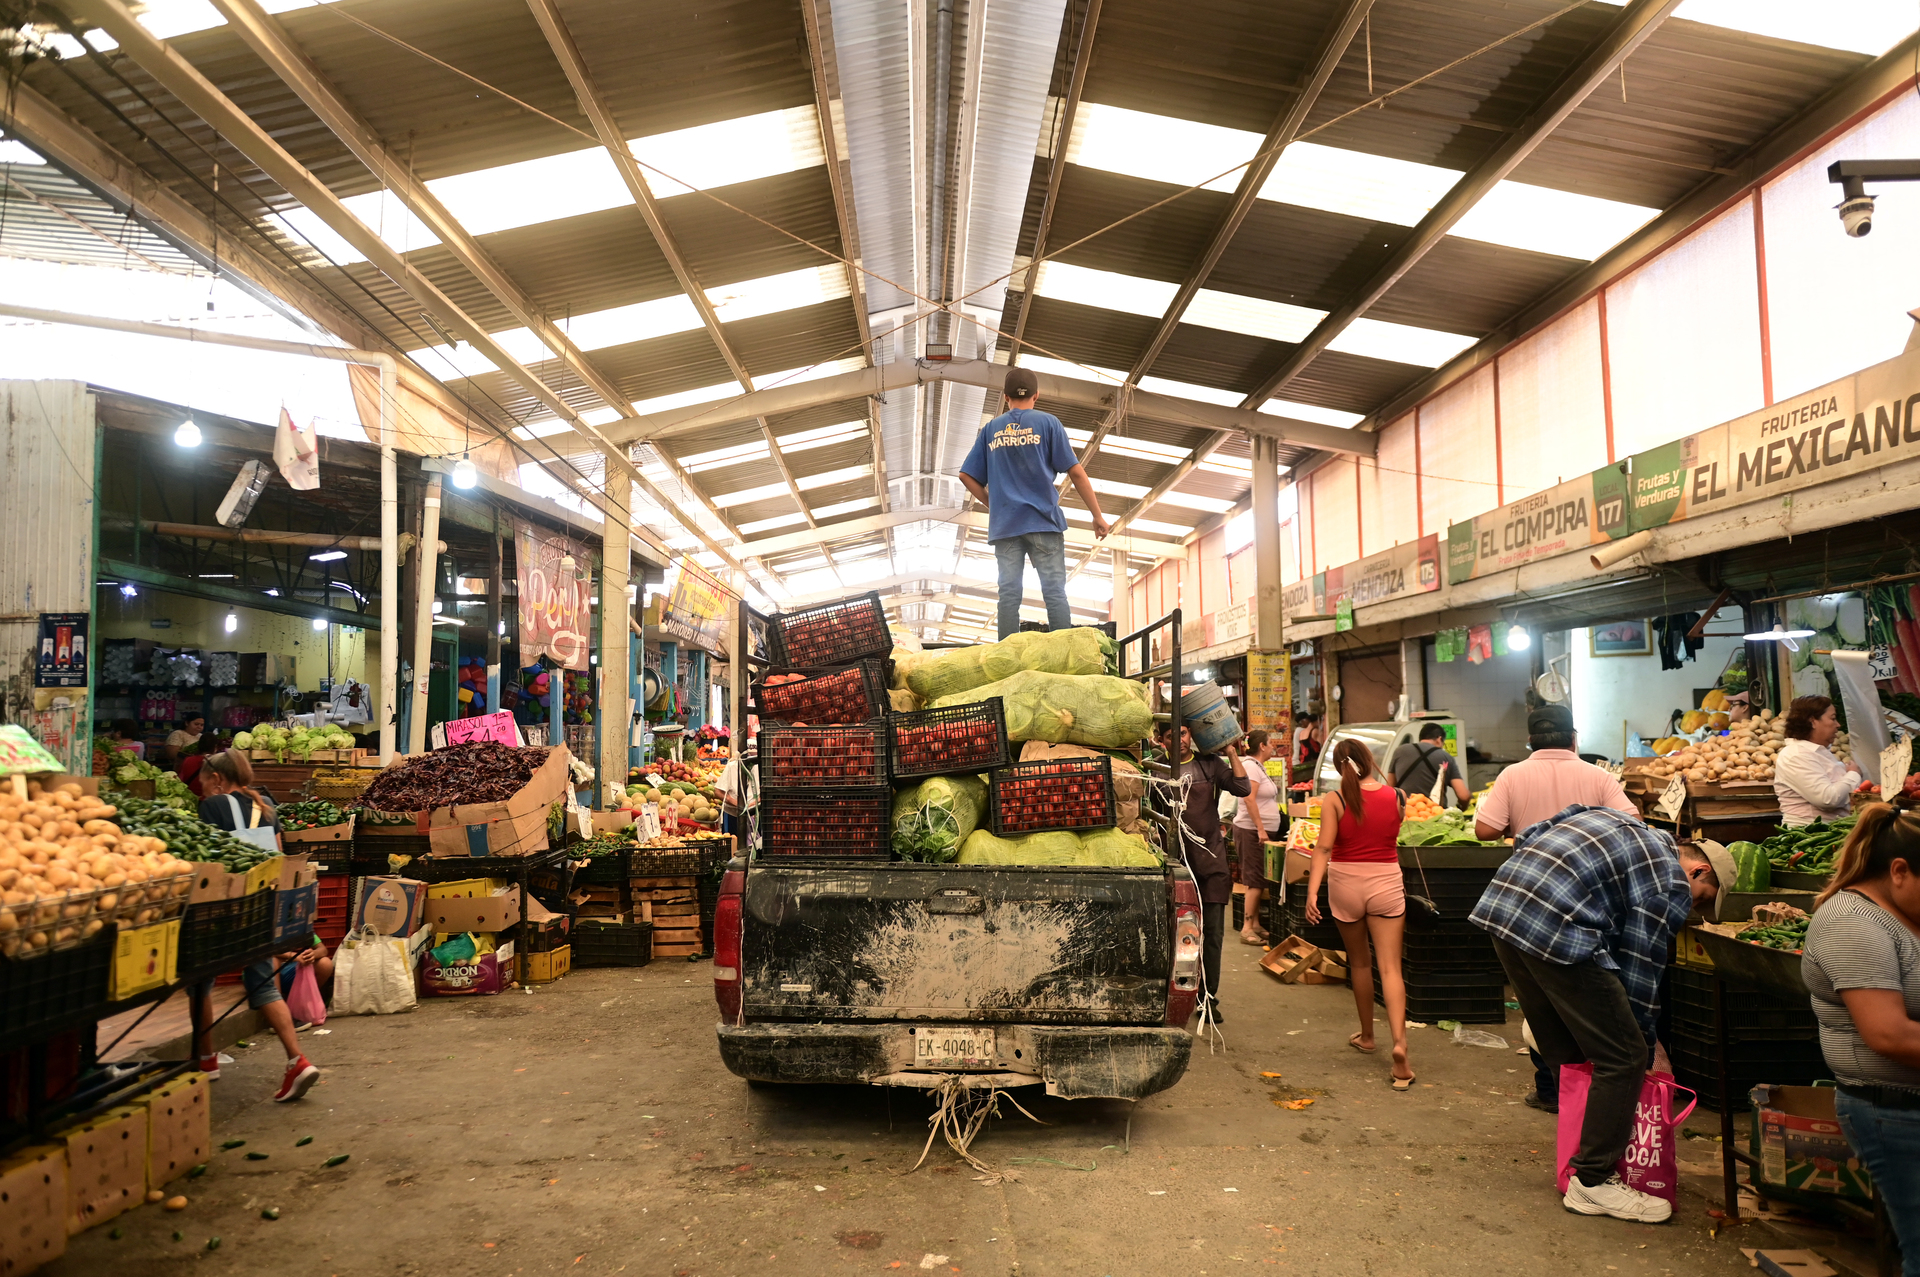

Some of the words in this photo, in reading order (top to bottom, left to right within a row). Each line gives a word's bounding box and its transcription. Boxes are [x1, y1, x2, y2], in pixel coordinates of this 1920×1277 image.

[1761, 396, 1838, 438] FRUTERIA
[988, 434, 1041, 451] WARRIORS
[1692, 461, 1726, 505] EL
[1737, 391, 1920, 492] MEXICANO
[1637, 472, 1670, 492] Frutas
[1672, 469, 1680, 485] y
[1510, 495, 1549, 518] FRUTERIA
[1634, 485, 1680, 508] Verduras
[1599, 499, 1622, 526] 177
[1480, 529, 1499, 559] EL
[1504, 497, 1588, 551] COMPIRA
[1421, 562, 1435, 581] 175
[1352, 567, 1405, 602] MENDOZA
[1282, 584, 1309, 611] ENDOZA
[667, 619, 693, 641] MAYOREO
[434, 965, 478, 978] NORDIC
[918, 1038, 992, 1057] EK-4048-C
[1635, 1101, 1661, 1124] AKE
[1625, 1144, 1660, 1167] OGA
